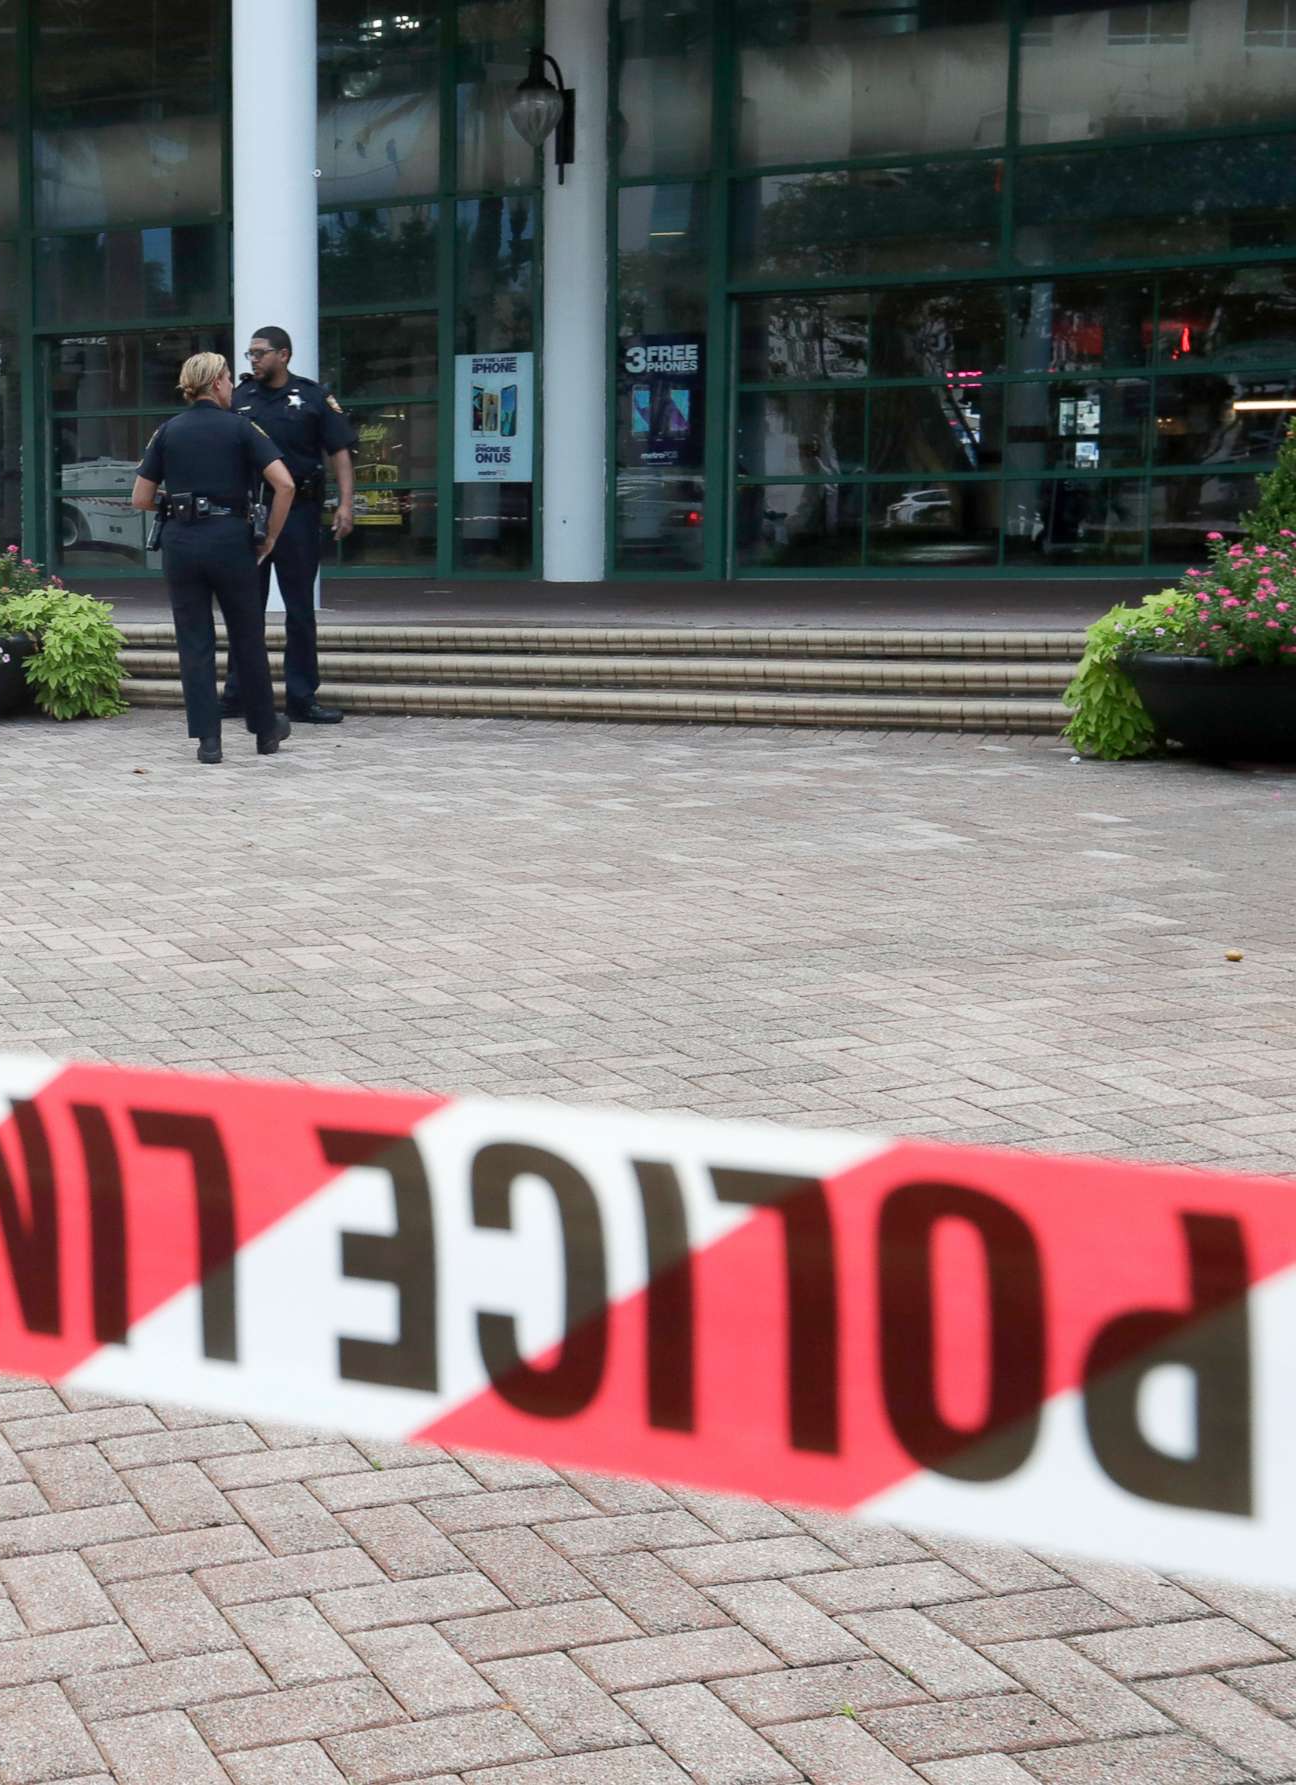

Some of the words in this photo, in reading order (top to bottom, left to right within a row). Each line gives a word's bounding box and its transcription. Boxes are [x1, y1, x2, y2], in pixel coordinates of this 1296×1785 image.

[625, 346, 646, 373] 3
[647, 344, 698, 361] FREE
[646, 361, 698, 373] PHONES
[475, 453, 492, 463] ON
[495, 452, 511, 463] US
[314, 1122, 1259, 1518] POLICE
